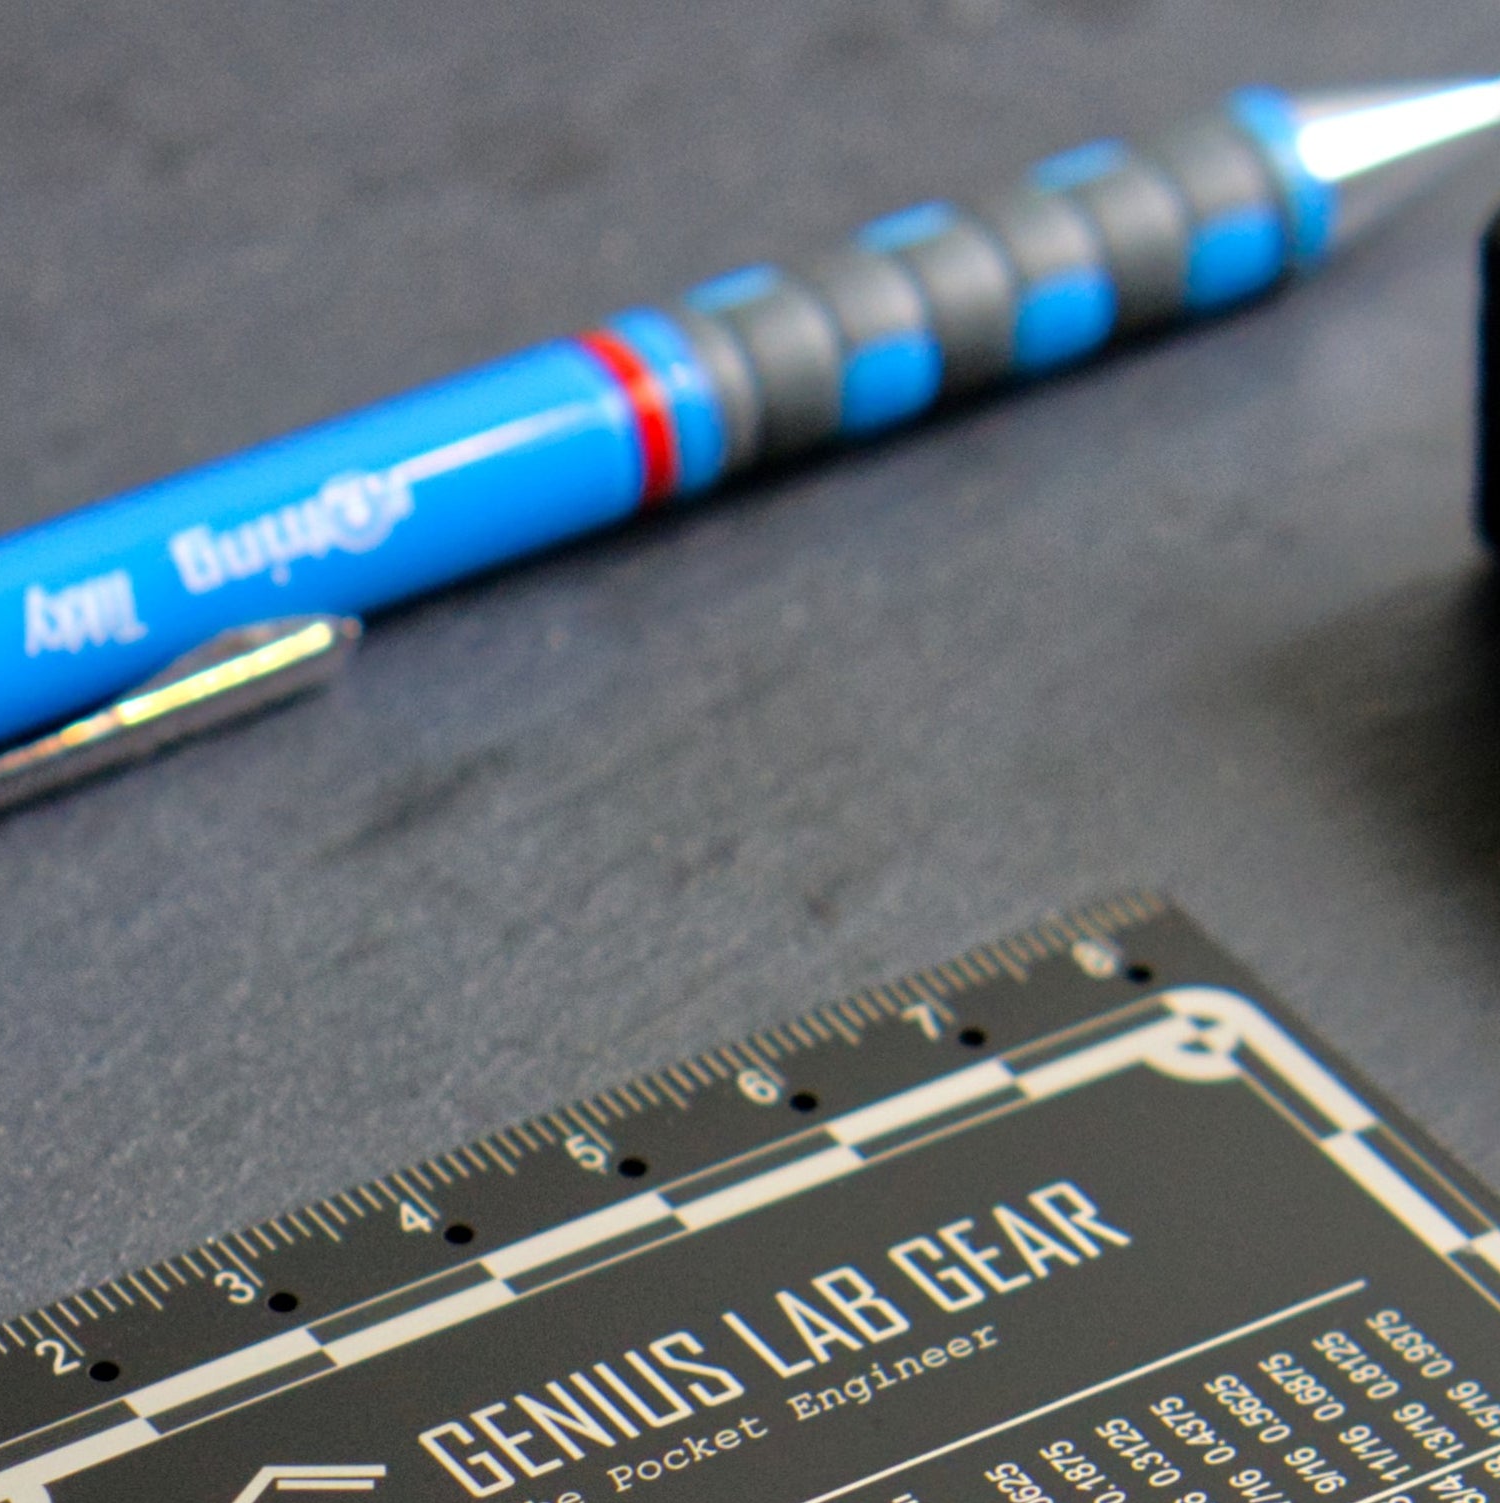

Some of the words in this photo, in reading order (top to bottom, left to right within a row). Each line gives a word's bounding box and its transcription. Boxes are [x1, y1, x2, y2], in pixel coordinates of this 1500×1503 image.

[35, 1339, 81, 1375] 2
[214, 1270, 256, 1304] 3
[399, 1201, 432, 1233] 4
[564, 1134, 606, 1172] 5
[737, 1069, 779, 1104] 6
[902, 1001, 940, 1040] 7
[418, 1331, 745, 1498] GENIUS
[722, 1266, 910, 1379] LAB
[888, 1182, 1131, 1313] GEAR
[1311, 1331, 1399, 1400] 0.8125
[1365, 1310, 1454, 1379] 0.9375
[606, 1418, 768, 1493] Pocket
[786, 1325, 998, 1421] Engineer
[1204, 1374, 1291, 1443] 0.5625
[1258, 1353, 1345, 1422] 0.6875
[1095, 1418, 1181, 1487] 0.3125
[1149, 1396, 1236, 1465] 0.4375
[1338, 1425, 1411, 1481] 11/16
[1392, 1402, 1464, 1459] 13/16
[1283, 1447, 1347, 1494] 9/16
